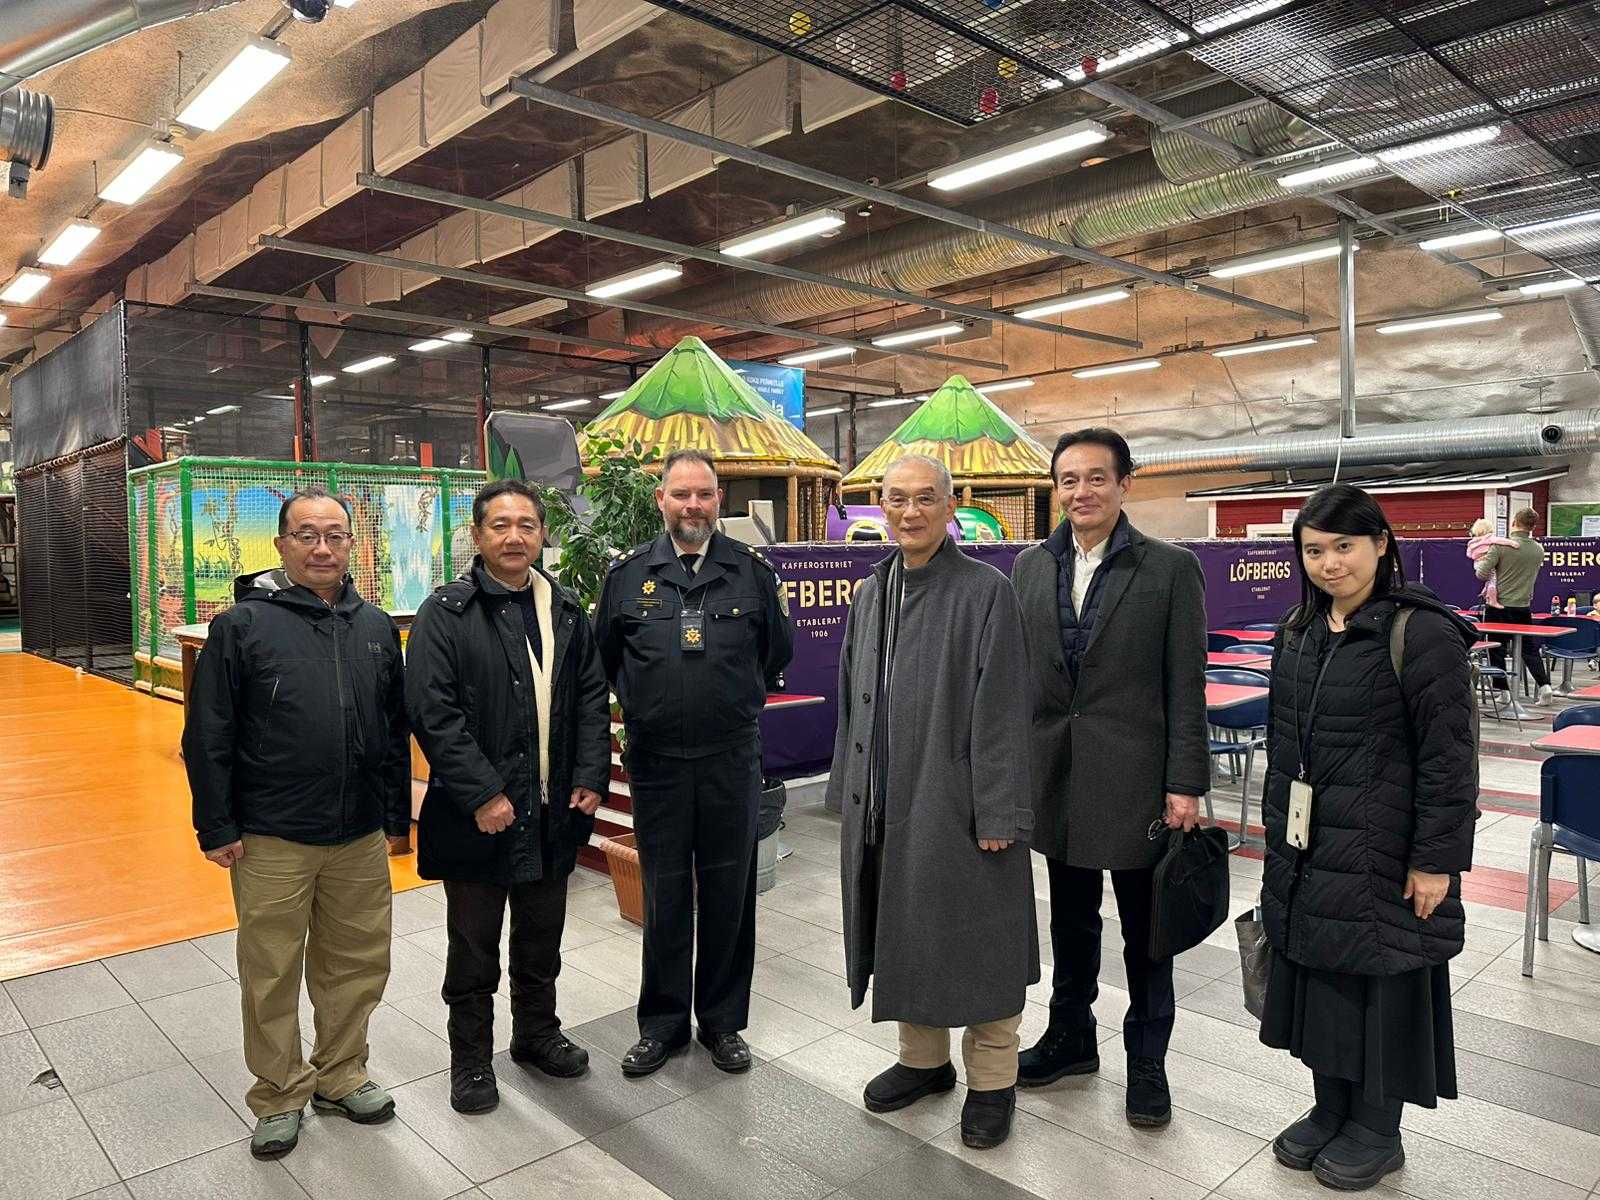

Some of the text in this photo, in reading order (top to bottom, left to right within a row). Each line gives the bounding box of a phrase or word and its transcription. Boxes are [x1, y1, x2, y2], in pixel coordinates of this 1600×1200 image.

[782, 560, 853, 569] KAFFEROSTERIET
[1540, 552, 1600, 566] FBER
[1230, 559, 1291, 582] LÖFBERGS
[796, 617, 841, 627] ETABLERAT
